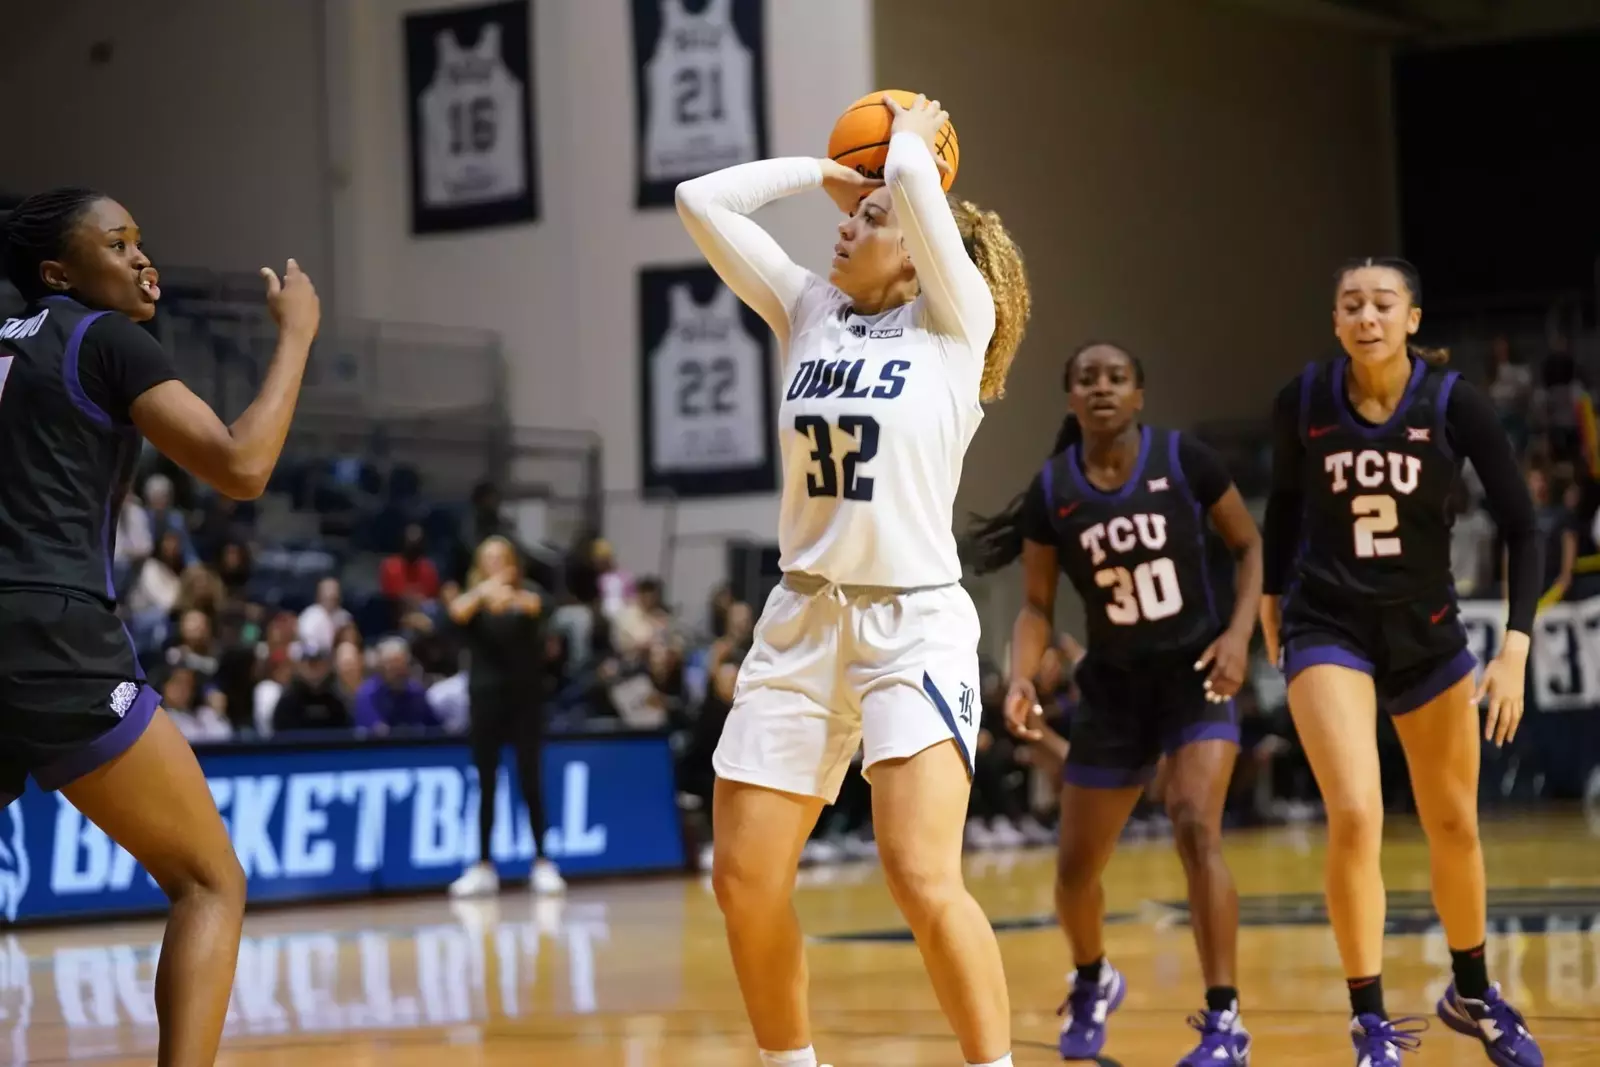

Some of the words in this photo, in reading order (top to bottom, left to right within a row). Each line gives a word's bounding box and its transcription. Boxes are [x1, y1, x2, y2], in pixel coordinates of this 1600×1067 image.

[674, 66, 725, 125] 21
[447, 96, 498, 156] 16
[677, 357, 737, 416] 22
[787, 359, 911, 400] OWLS
[795, 415, 880, 502] 32
[1324, 449, 1421, 495] TCU
[1080, 513, 1167, 566] TCU
[1351, 494, 1402, 558] 2
[1095, 556, 1183, 625] 30
[50, 760, 608, 896] BKETBAL
